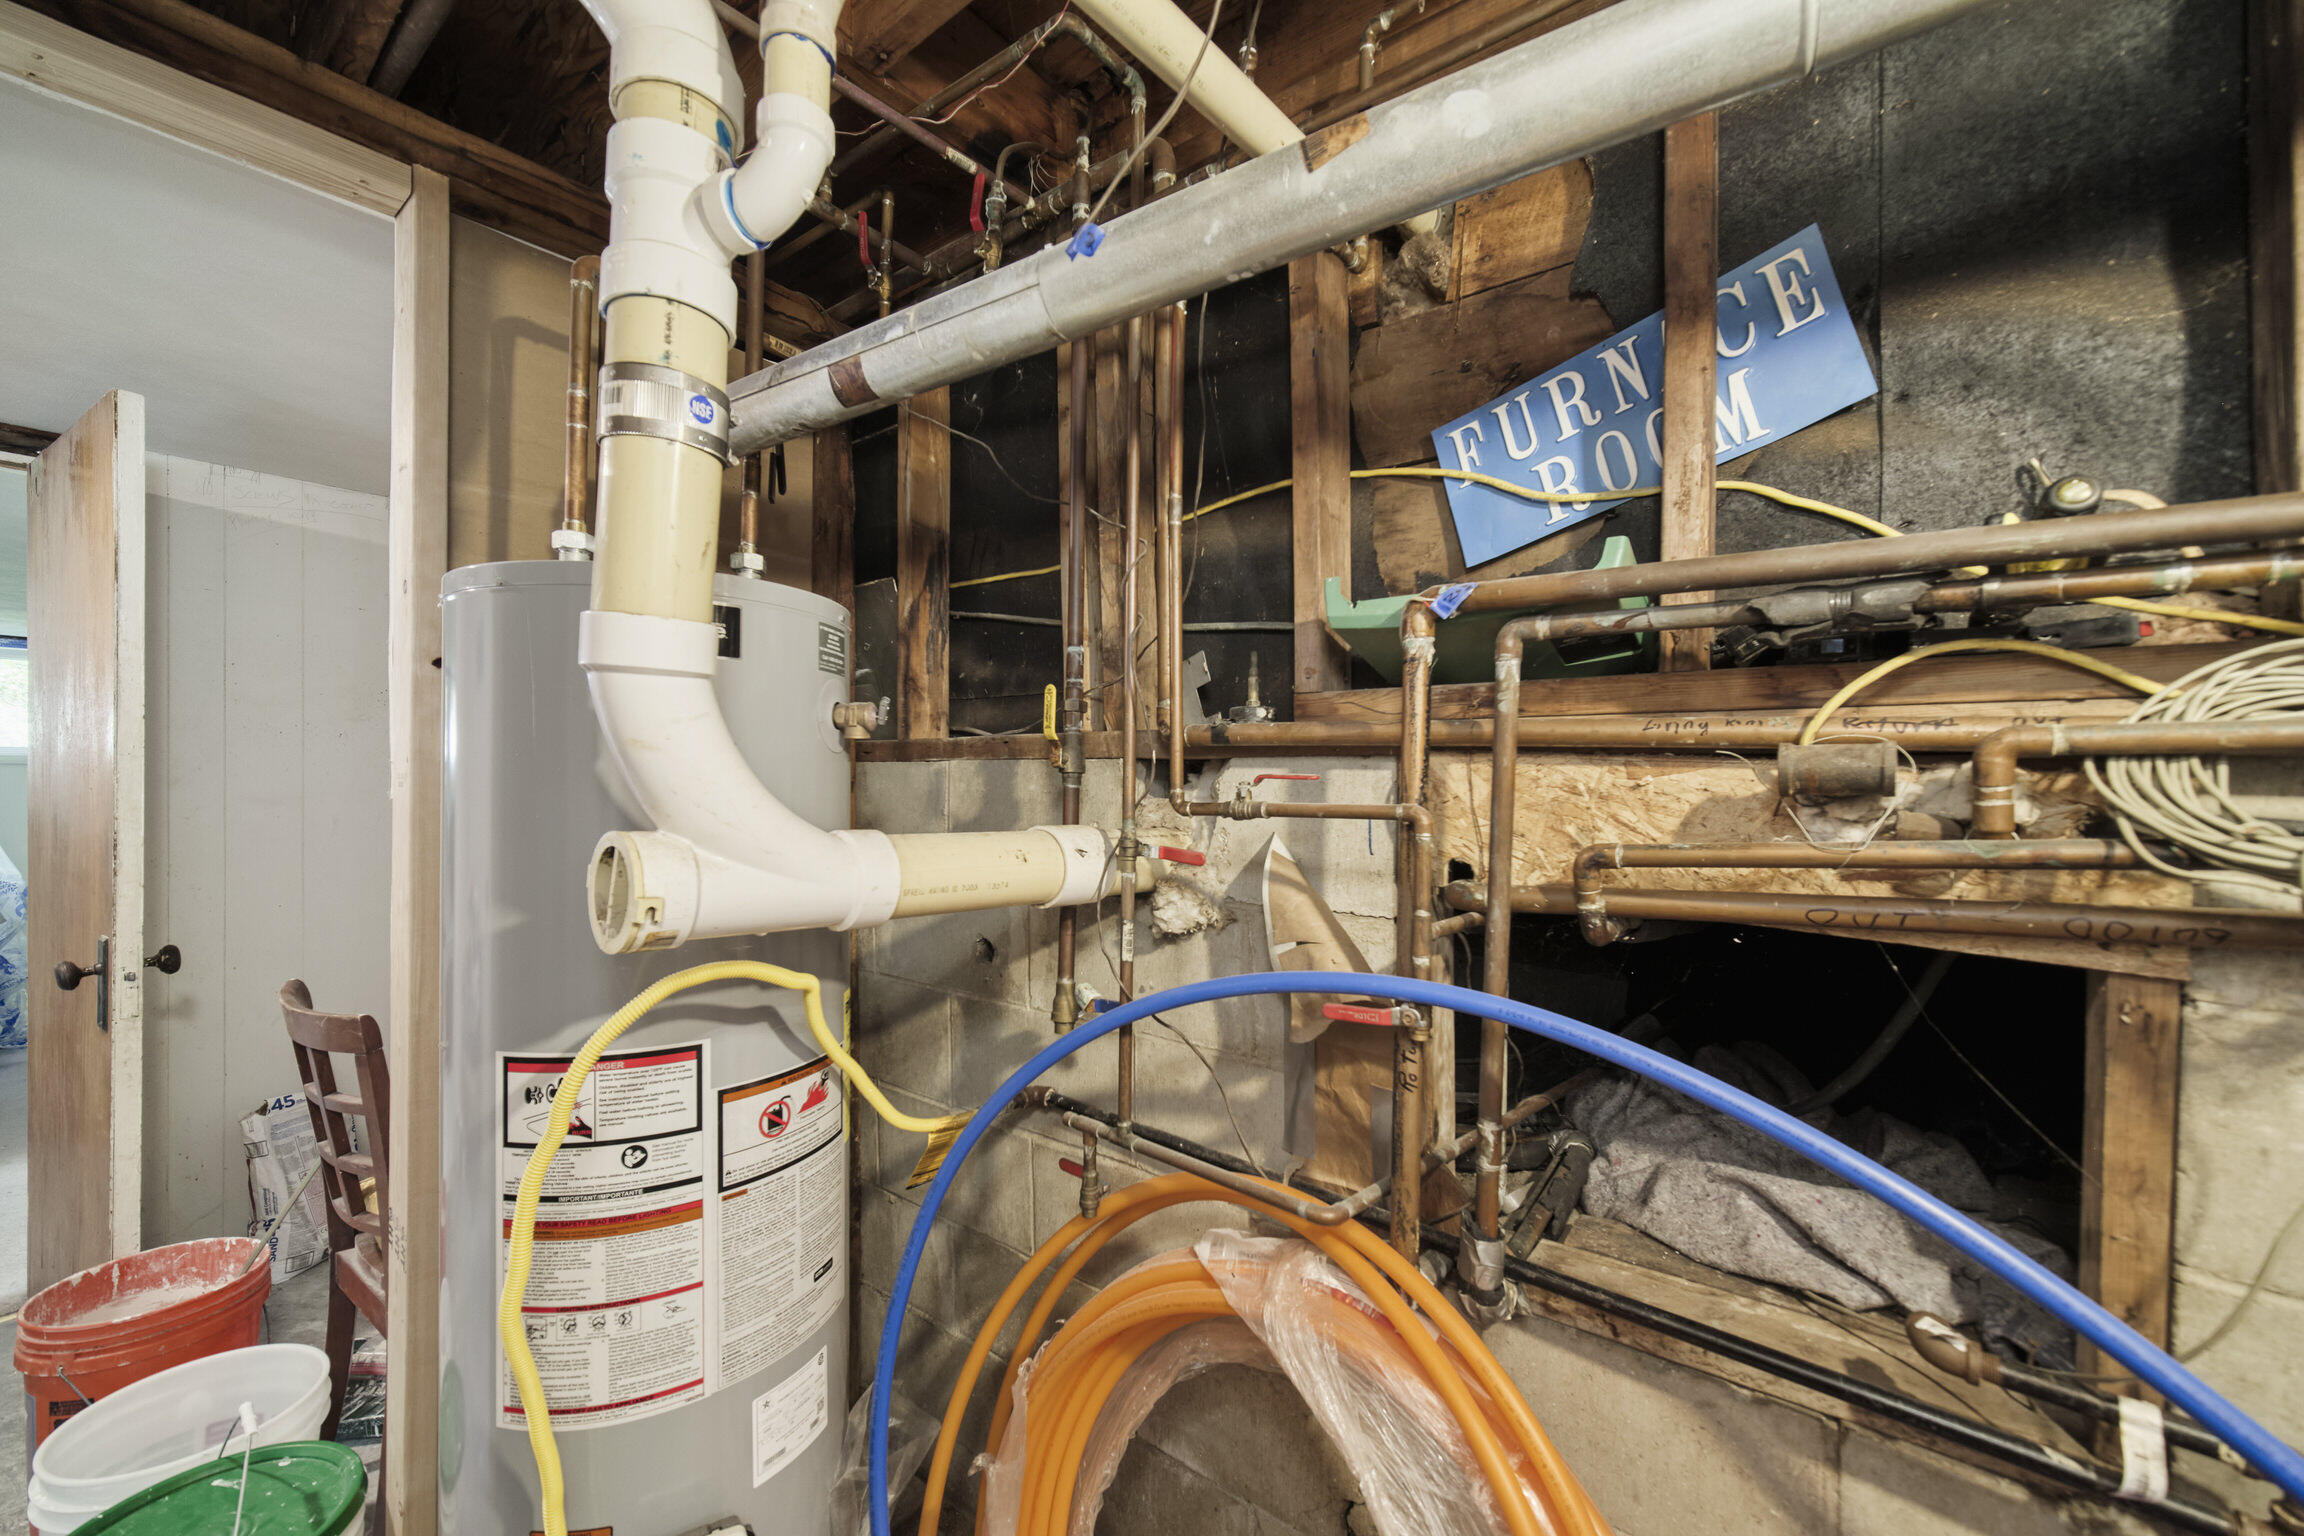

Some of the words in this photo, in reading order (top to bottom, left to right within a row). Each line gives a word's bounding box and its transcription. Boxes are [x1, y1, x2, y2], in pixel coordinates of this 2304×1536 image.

[1446, 247, 1826, 490] FURNCE
[590, 1061, 625, 1071] ANGER
[268, 1236, 280, 1262] SAND
